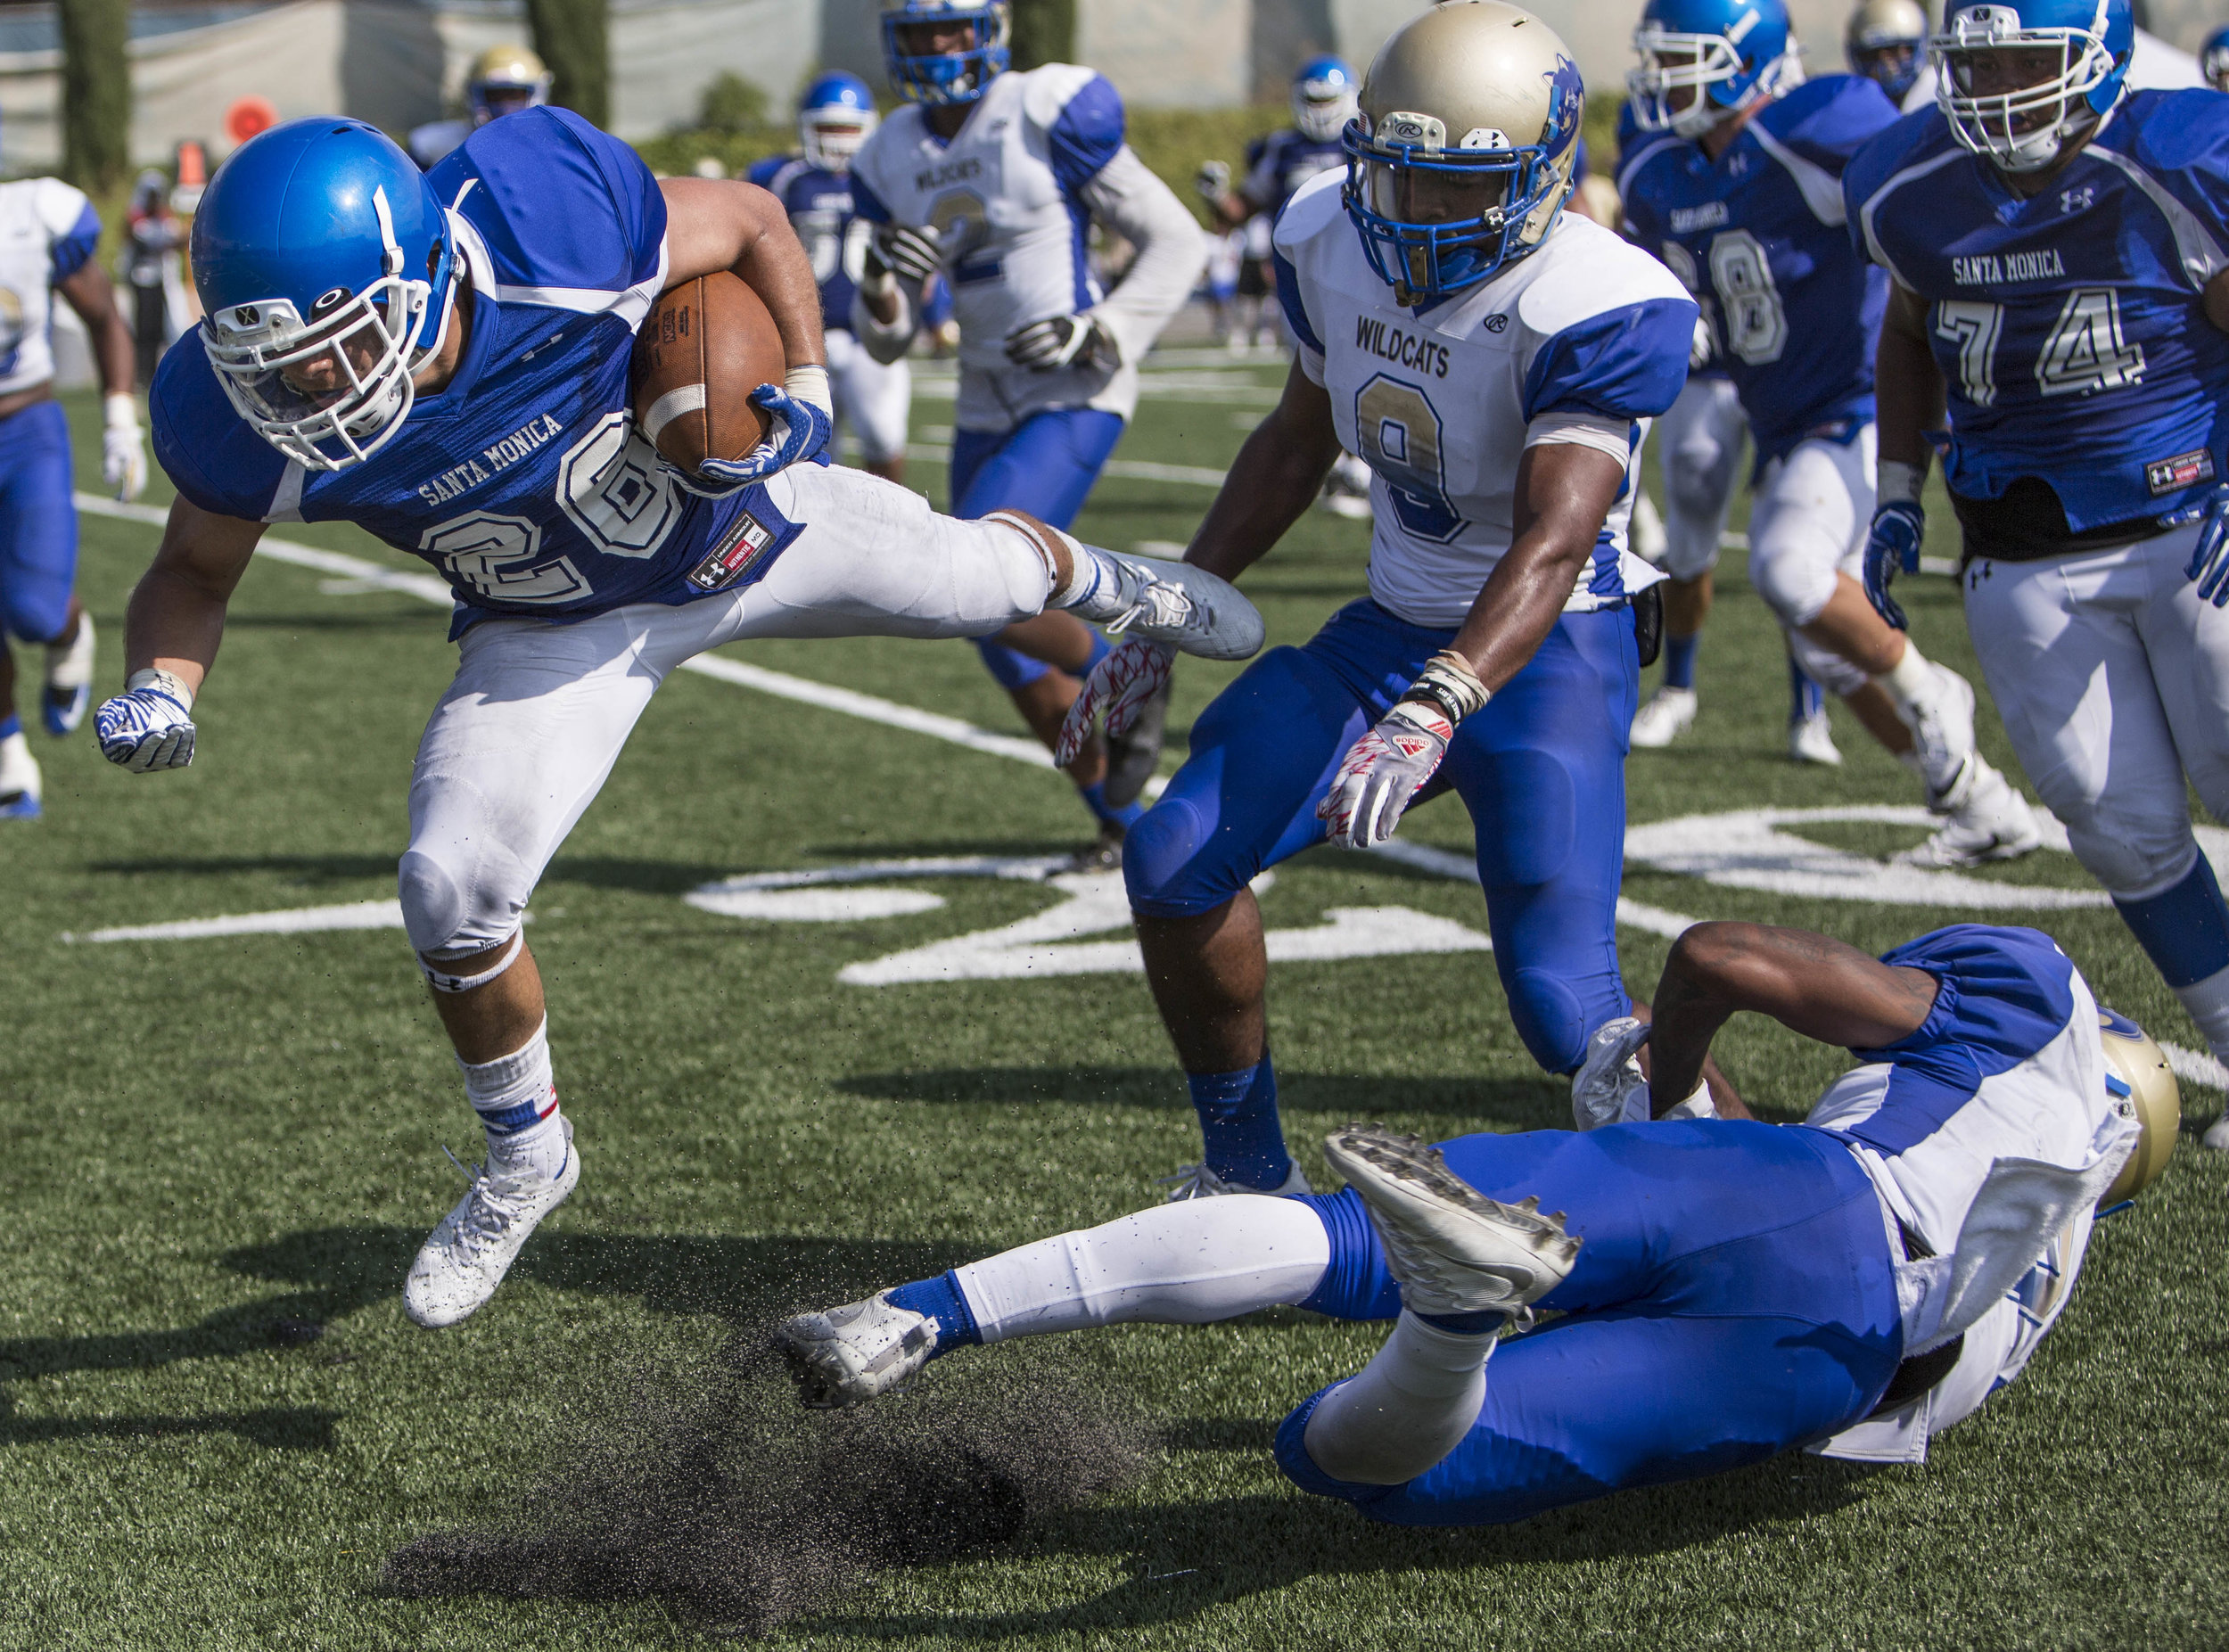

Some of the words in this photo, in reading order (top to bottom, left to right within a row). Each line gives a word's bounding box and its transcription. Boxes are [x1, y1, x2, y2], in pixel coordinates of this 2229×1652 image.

[1953, 256, 2003, 285] SANTA
[2005, 248, 2066, 282] MONICA
[1356, 315, 1450, 379] WILDCATS
[1936, 287, 2147, 407] 74
[419, 459, 490, 506] SANTA
[483, 413, 563, 472] MONICA
[728, 544, 752, 570] AUTHENTIC
